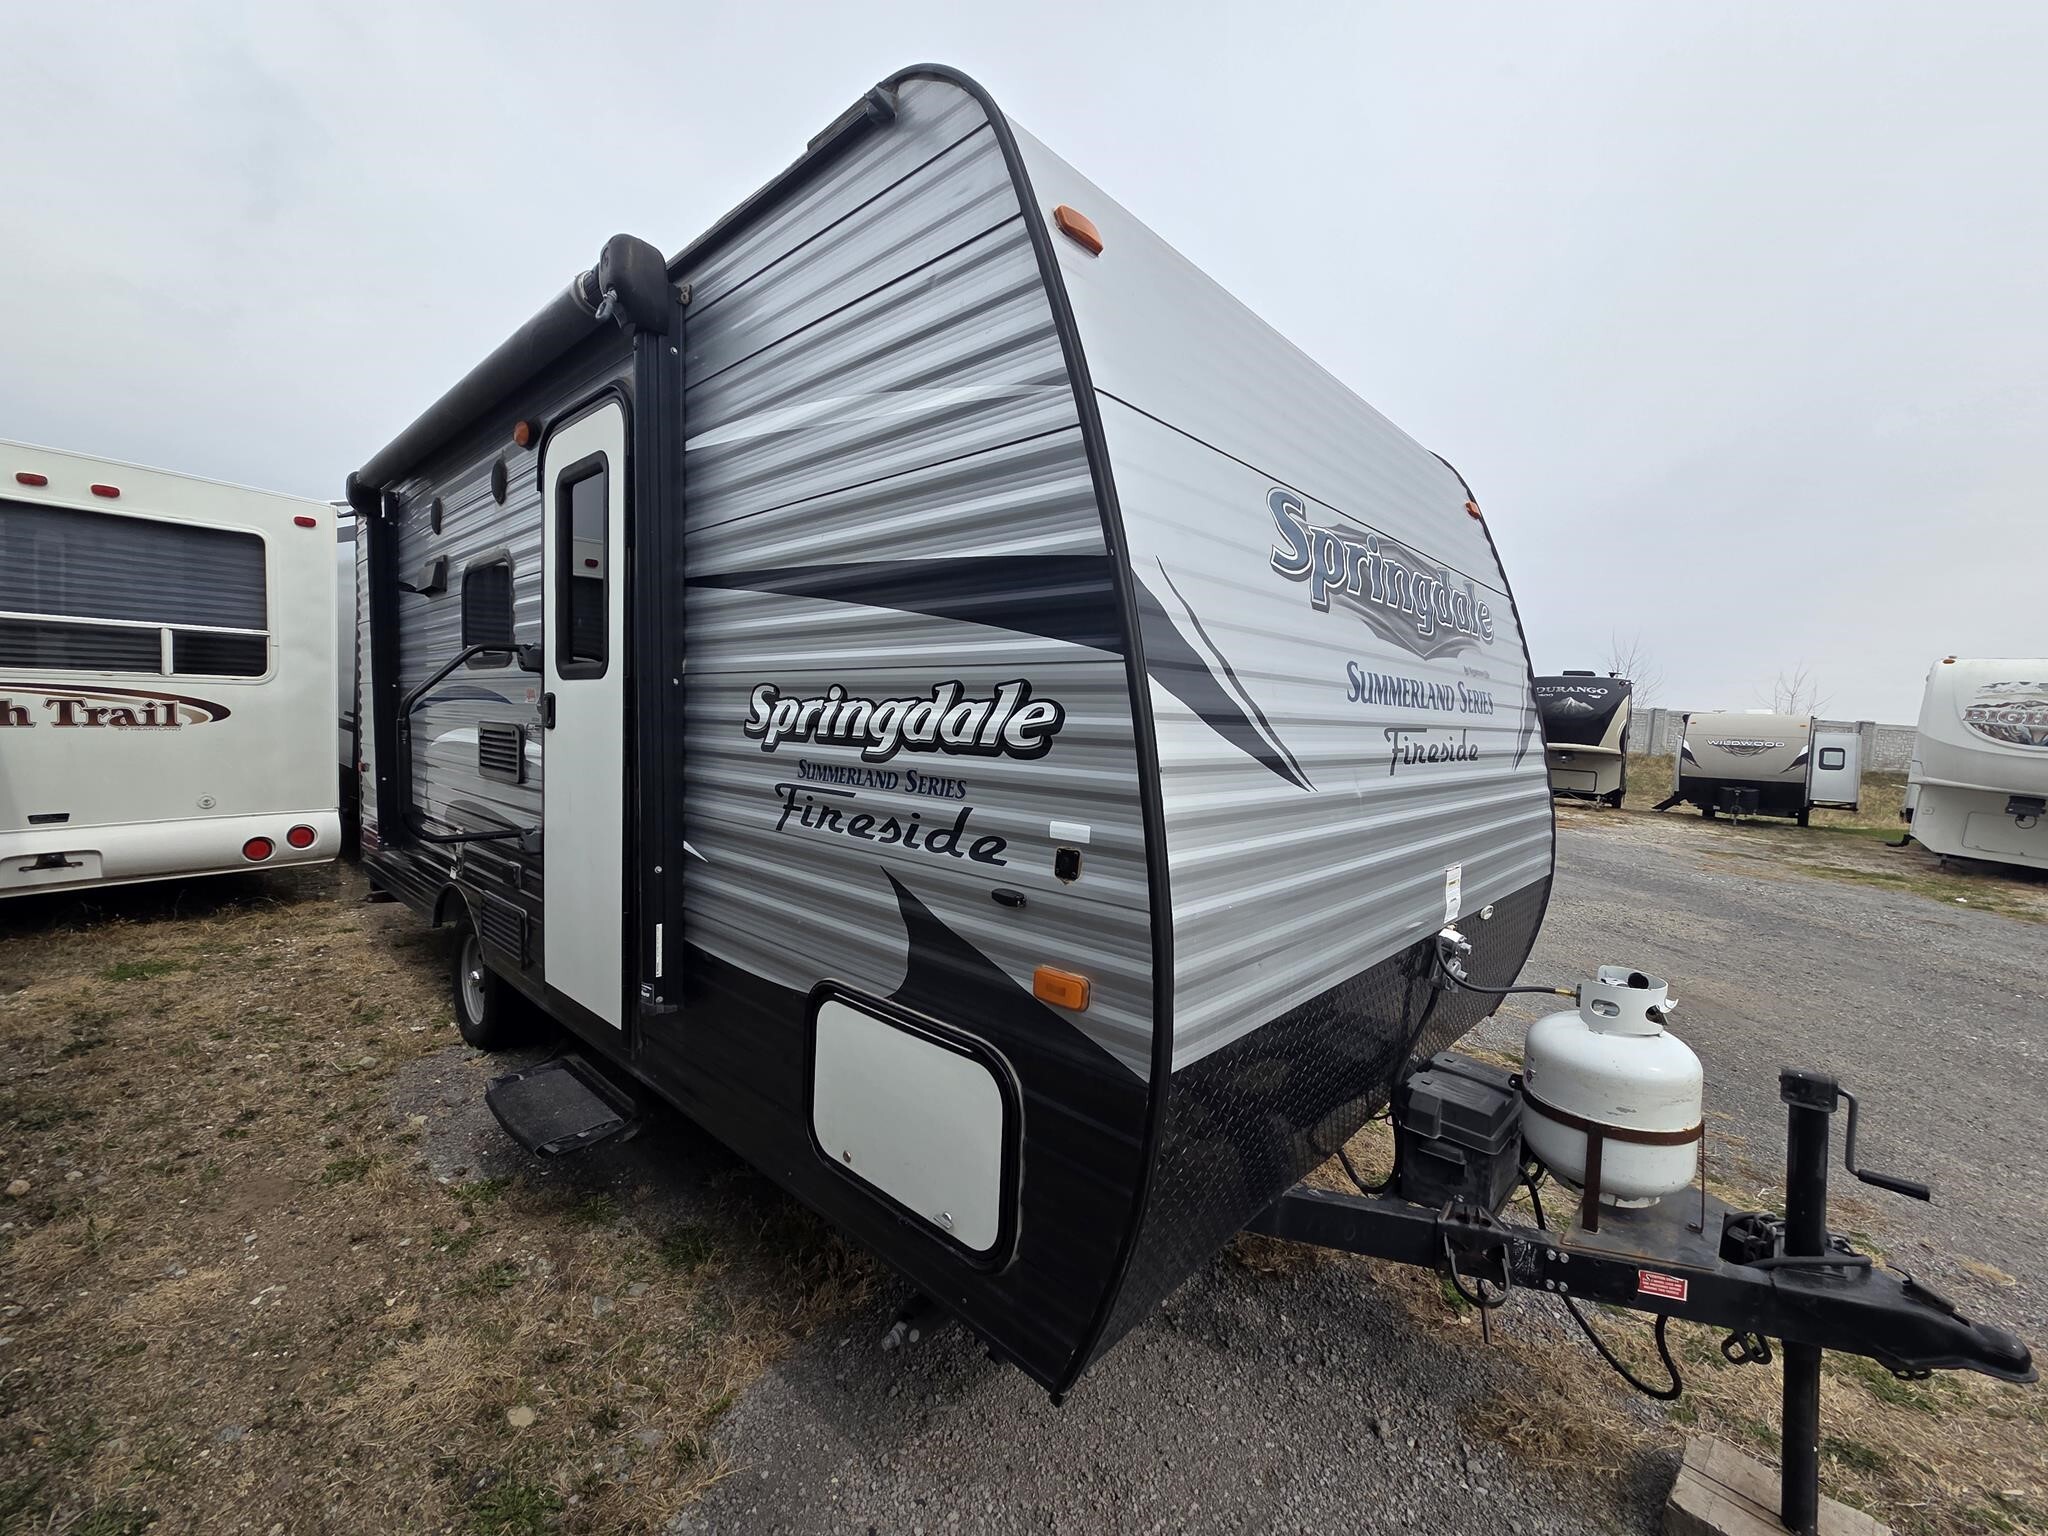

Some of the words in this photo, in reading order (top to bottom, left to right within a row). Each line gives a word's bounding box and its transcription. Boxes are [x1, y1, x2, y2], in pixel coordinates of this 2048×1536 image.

[1266, 486, 1495, 646] Springdale
[43, 697, 182, 729] Trail
[1346, 660, 1455, 711] SUMMERLAND
[1457, 681, 1494, 716] SERIES
[1536, 686, 1609, 695] DURANGO
[744, 679, 1066, 763] Springdale
[1706, 739, 1785, 748] WILDWOOD
[1383, 727, 1479, 777] Fireside
[797, 758, 899, 791] SUMMERLAND
[904, 769, 968, 799] SERIES
[774, 782, 1008, 867] Fireside
